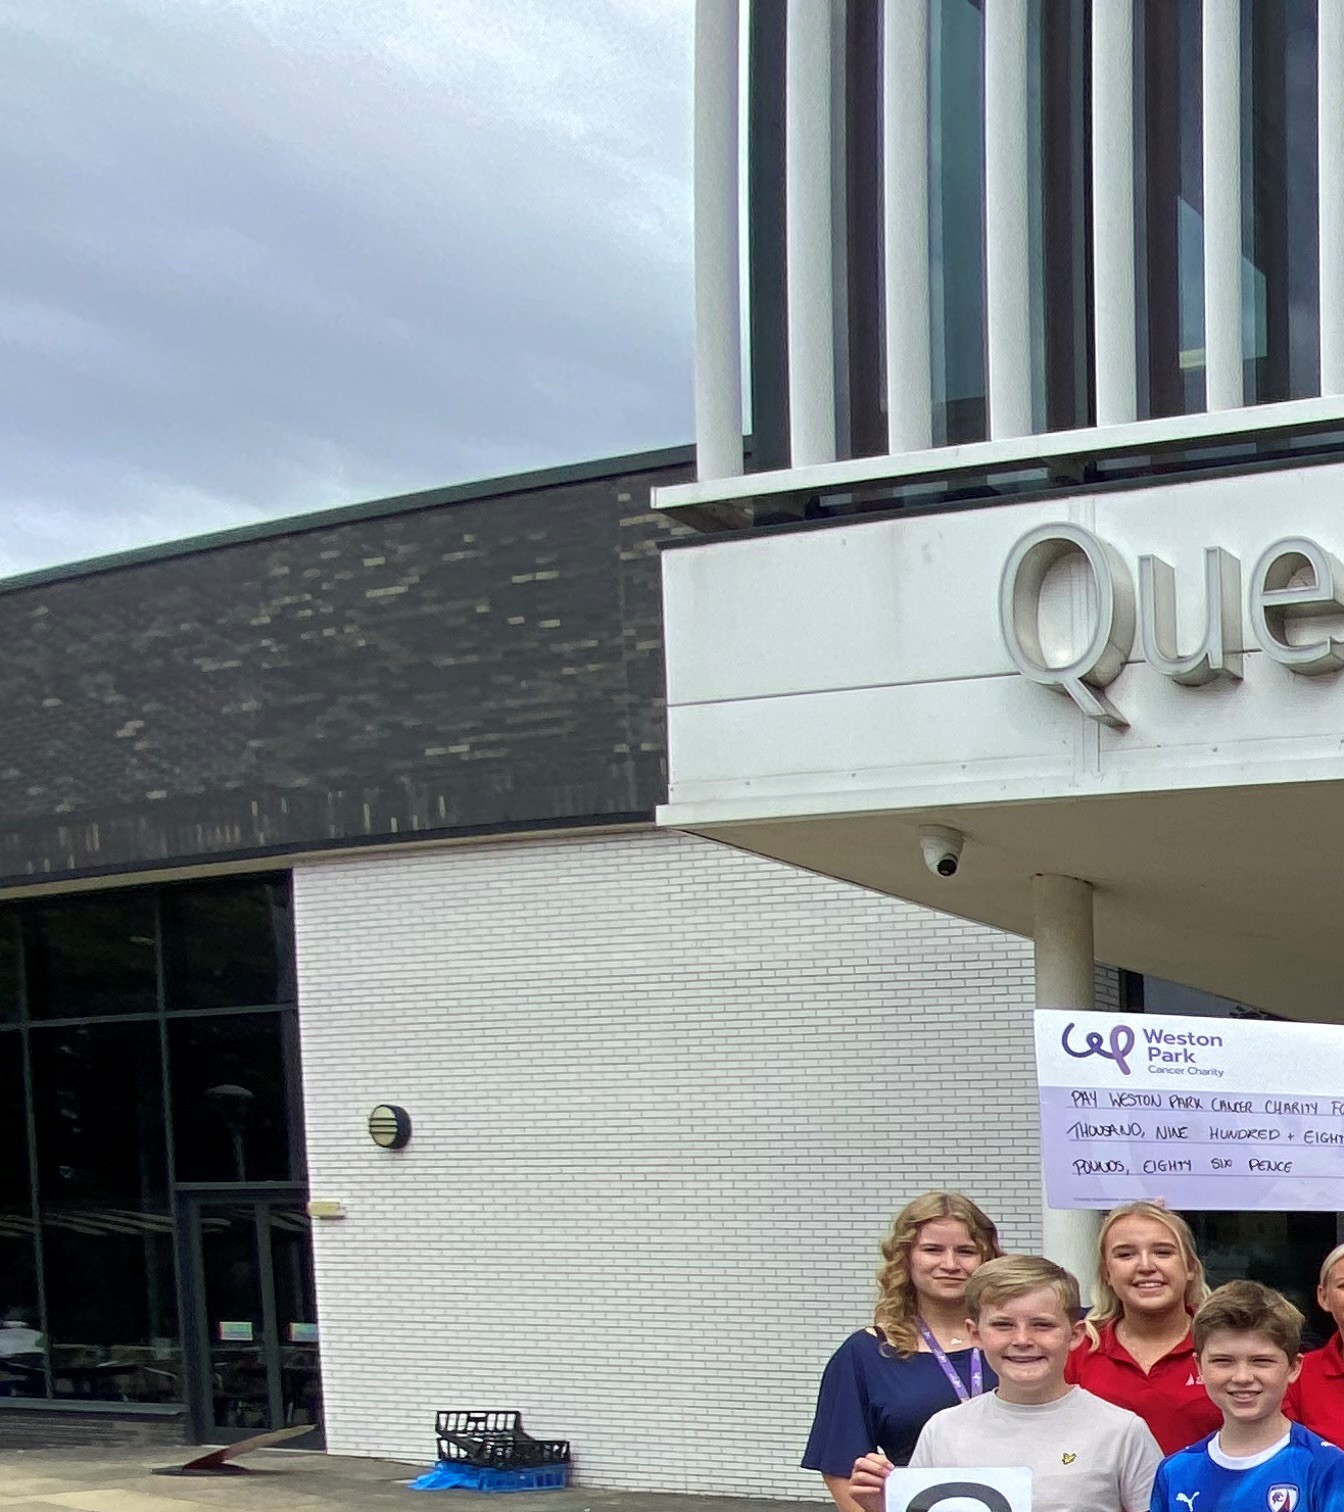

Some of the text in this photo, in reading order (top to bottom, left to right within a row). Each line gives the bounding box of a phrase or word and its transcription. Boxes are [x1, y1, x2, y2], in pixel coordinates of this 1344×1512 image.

[1143, 1028, 1223, 1047] Weston
[1148, 1046, 1196, 1064] Park
[1148, 1065, 1224, 1078] Cancer Charity
[1071, 1090, 1097, 1108] PAY
[1109, 1092, 1162, 1108] WESTON
[1169, 1095, 1204, 1110] PARK
[1211, 1099, 1253, 1113] CANCER
[1265, 1100, 1318, 1115] CHARITY
[1156, 1126, 1189, 1139] NINE
[1209, 1126, 1281, 1140] HUNDRED
[1143, 1159, 1192, 1173] EIGHTY
[1210, 1158, 1233, 1169] SIX
[1249, 1159, 1293, 1173] PENCE
